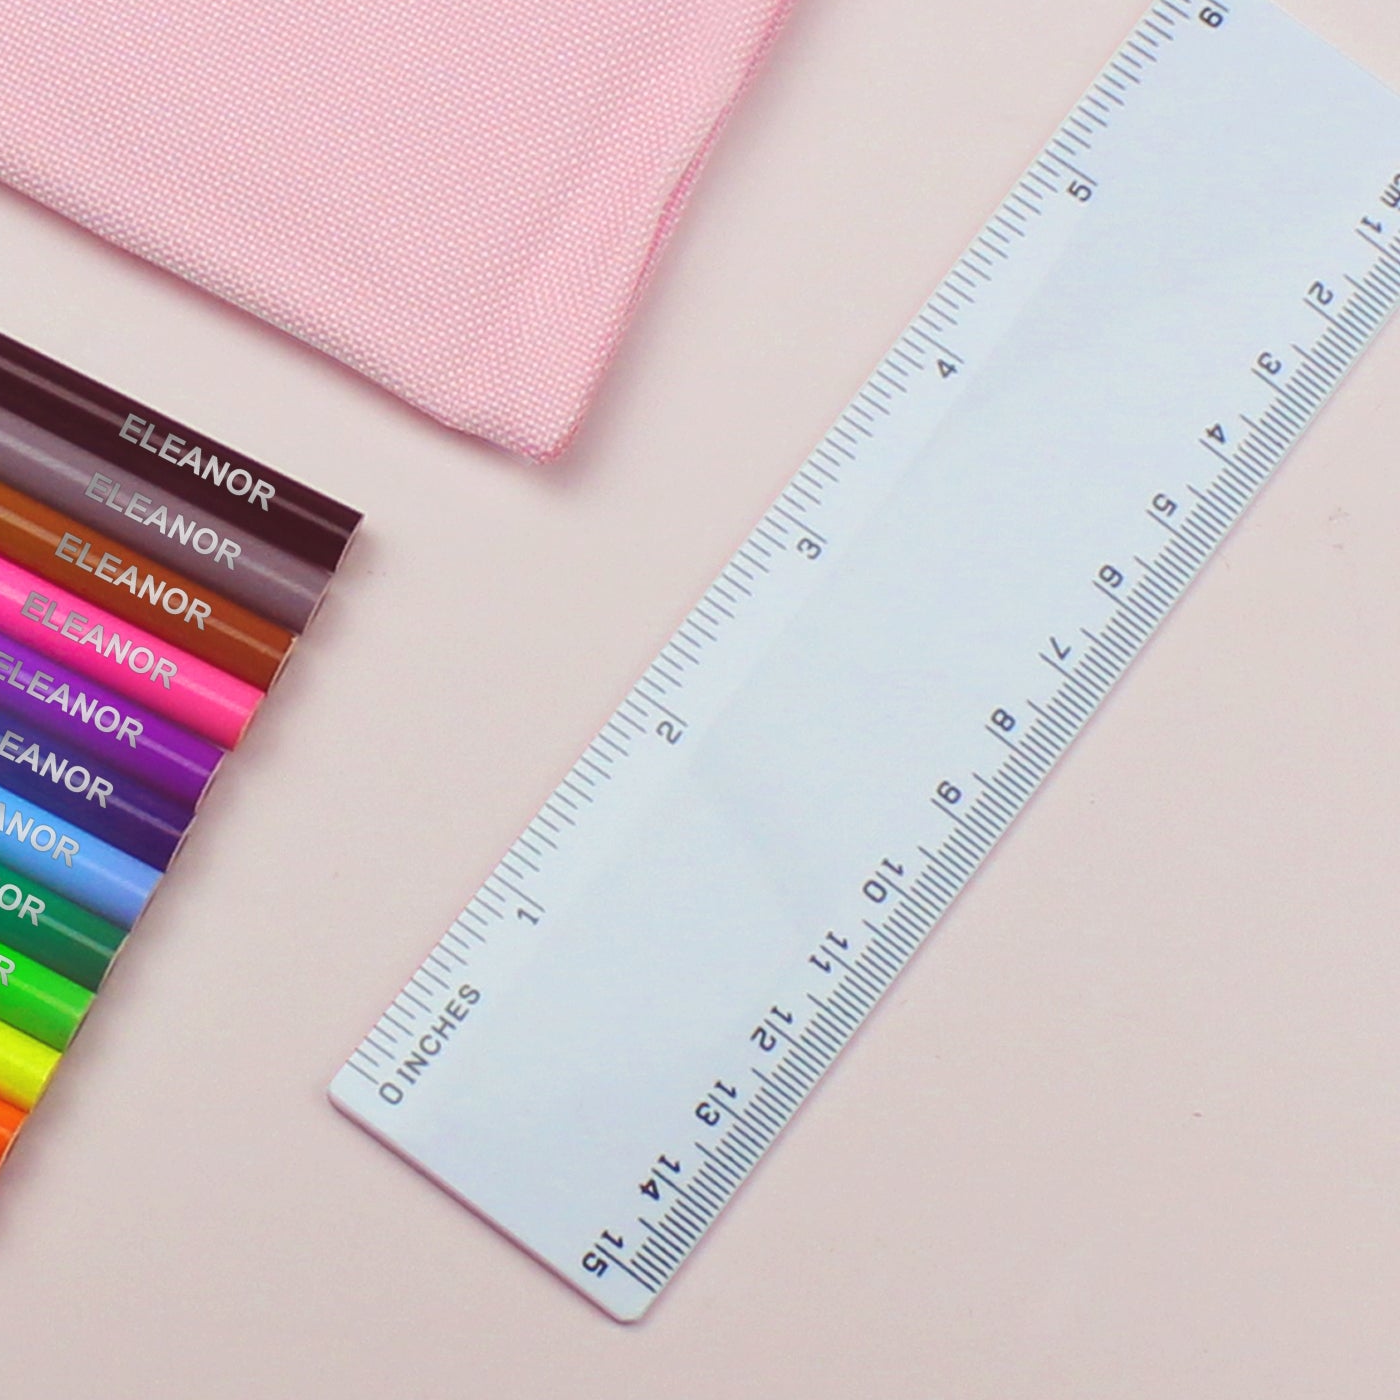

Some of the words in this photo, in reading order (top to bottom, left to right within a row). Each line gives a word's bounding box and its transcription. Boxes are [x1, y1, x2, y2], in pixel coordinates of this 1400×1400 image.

[1361, 216, 1381, 233] 1
[1310, 281, 1334, 306] 2
[1257, 351, 1282, 375] 3
[1204, 423, 1228, 444] 4
[119, 413, 276, 511] ELEANOR
[84, 472, 242, 570] ELEANOR
[1152, 493, 1178, 517] 5
[379, 1080, 404, 1105] 0
[401, 984, 482, 1083] INCHES
[517, 907, 540, 926] 1
[656, 719, 683, 744] 2
[797, 537, 822, 560] 3
[935, 359, 958, 379] 4
[1069, 180, 1093, 202] 5
[1199, 7, 1223, 27] 6
[1098, 564, 1124, 588] 6
[54, 533, 212, 630] ELEANOR
[20, 592, 178, 690] ELEANOR
[1049, 636, 1071, 660] 7
[991, 709, 1017, 731] 8
[938, 780, 963, 804] 9
[862, 858, 903, 905] 10
[808, 930, 848, 974] 11
[750, 1004, 793, 1052] 12
[695, 1079, 738, 1127] 13
[639, 1154, 681, 1201] 14
[582, 1229, 624, 1277] 15
